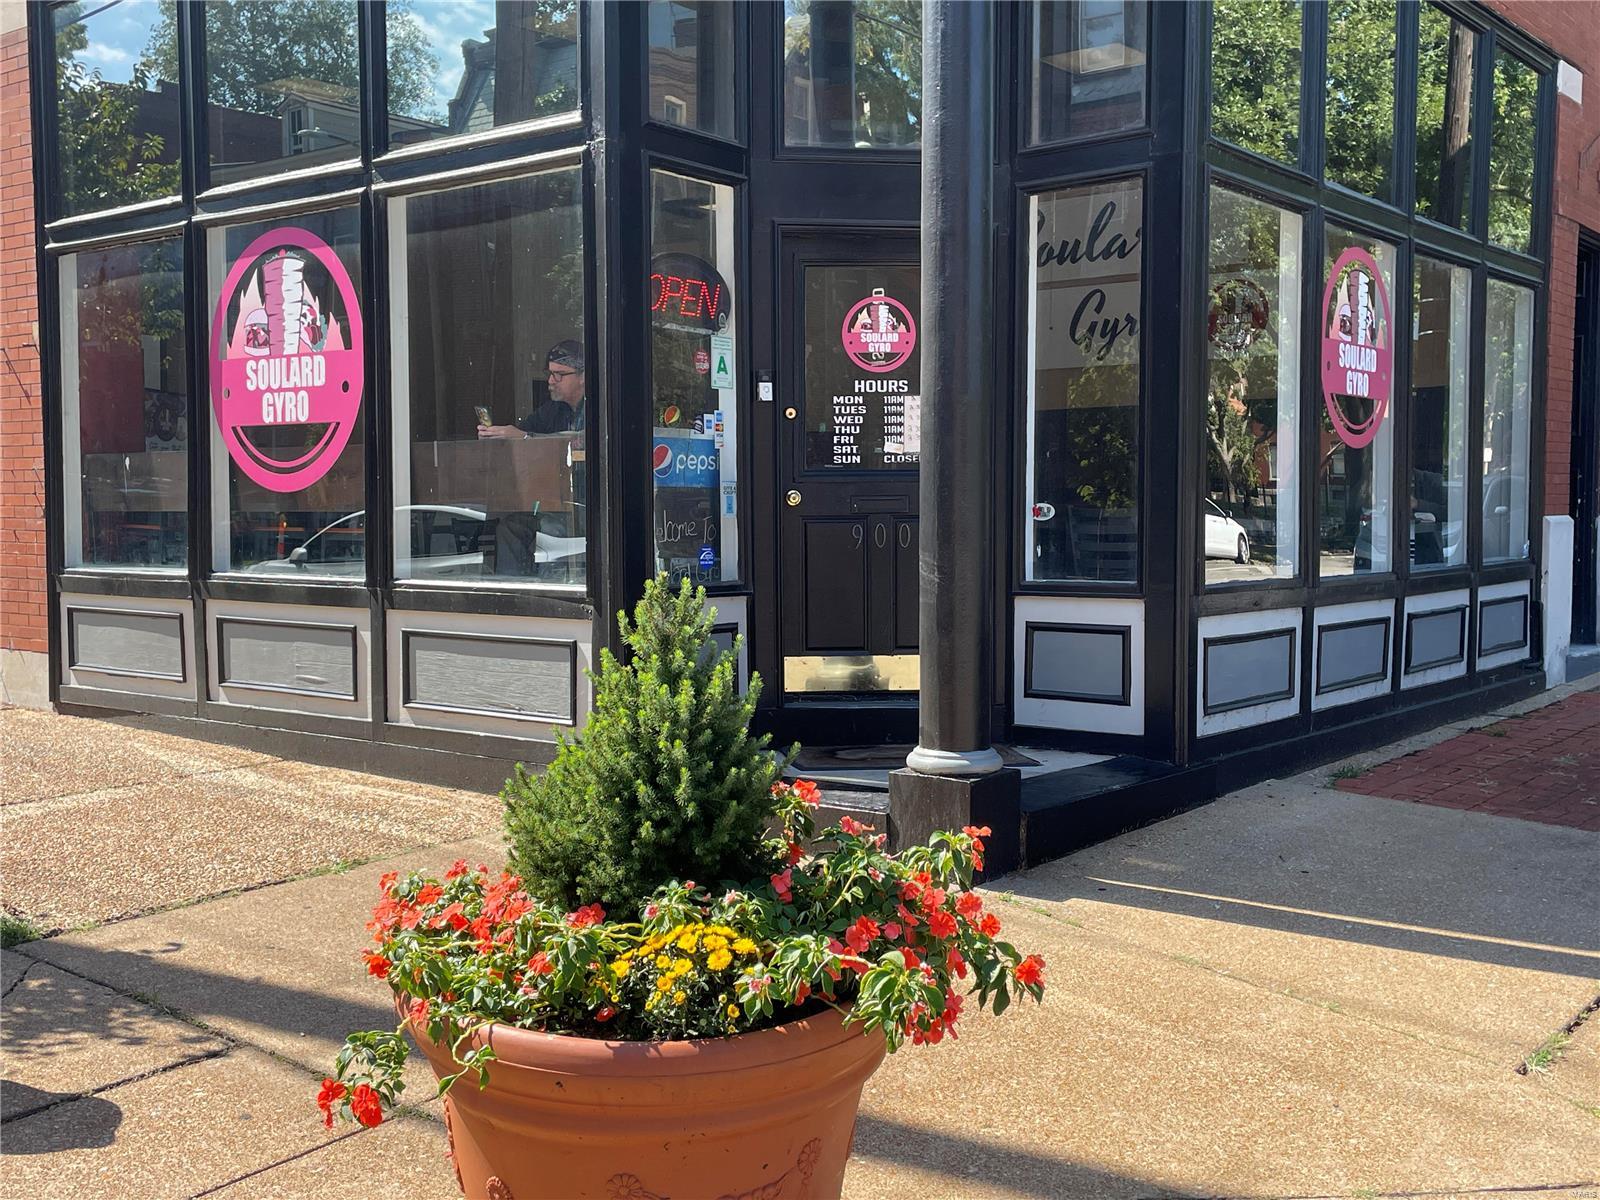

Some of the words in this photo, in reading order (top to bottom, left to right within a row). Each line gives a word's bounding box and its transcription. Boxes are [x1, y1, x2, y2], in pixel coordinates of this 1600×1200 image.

[1069, 288, 1140, 361] Gyr
[861, 332, 899, 343] SOULARD
[868, 342, 891, 353] GYRO
[1338, 342, 1377, 373] SOULARD
[717, 355, 728, 375] A
[246, 354, 326, 392] SOULARD
[854, 379, 908, 393] HOURS
[1346, 370, 1369, 398] GYRO
[833, 396, 863, 404] MON
[884, 396, 904, 404] 11AM
[262, 390, 309, 424] GYRO
[833, 406, 867, 414] TUES
[884, 406, 904, 414] 11AM
[833, 416, 863, 424] WED
[884, 416, 904, 424] 11AM
[833, 426, 860, 434] THU
[884, 426, 904, 434] 11AM
[833, 436, 854, 444] FRI
[833, 445, 859, 454] SAT
[833, 455, 860, 464] SUN
[884, 455, 920, 464] CLOSE
[852, 523, 910, 549] 900
